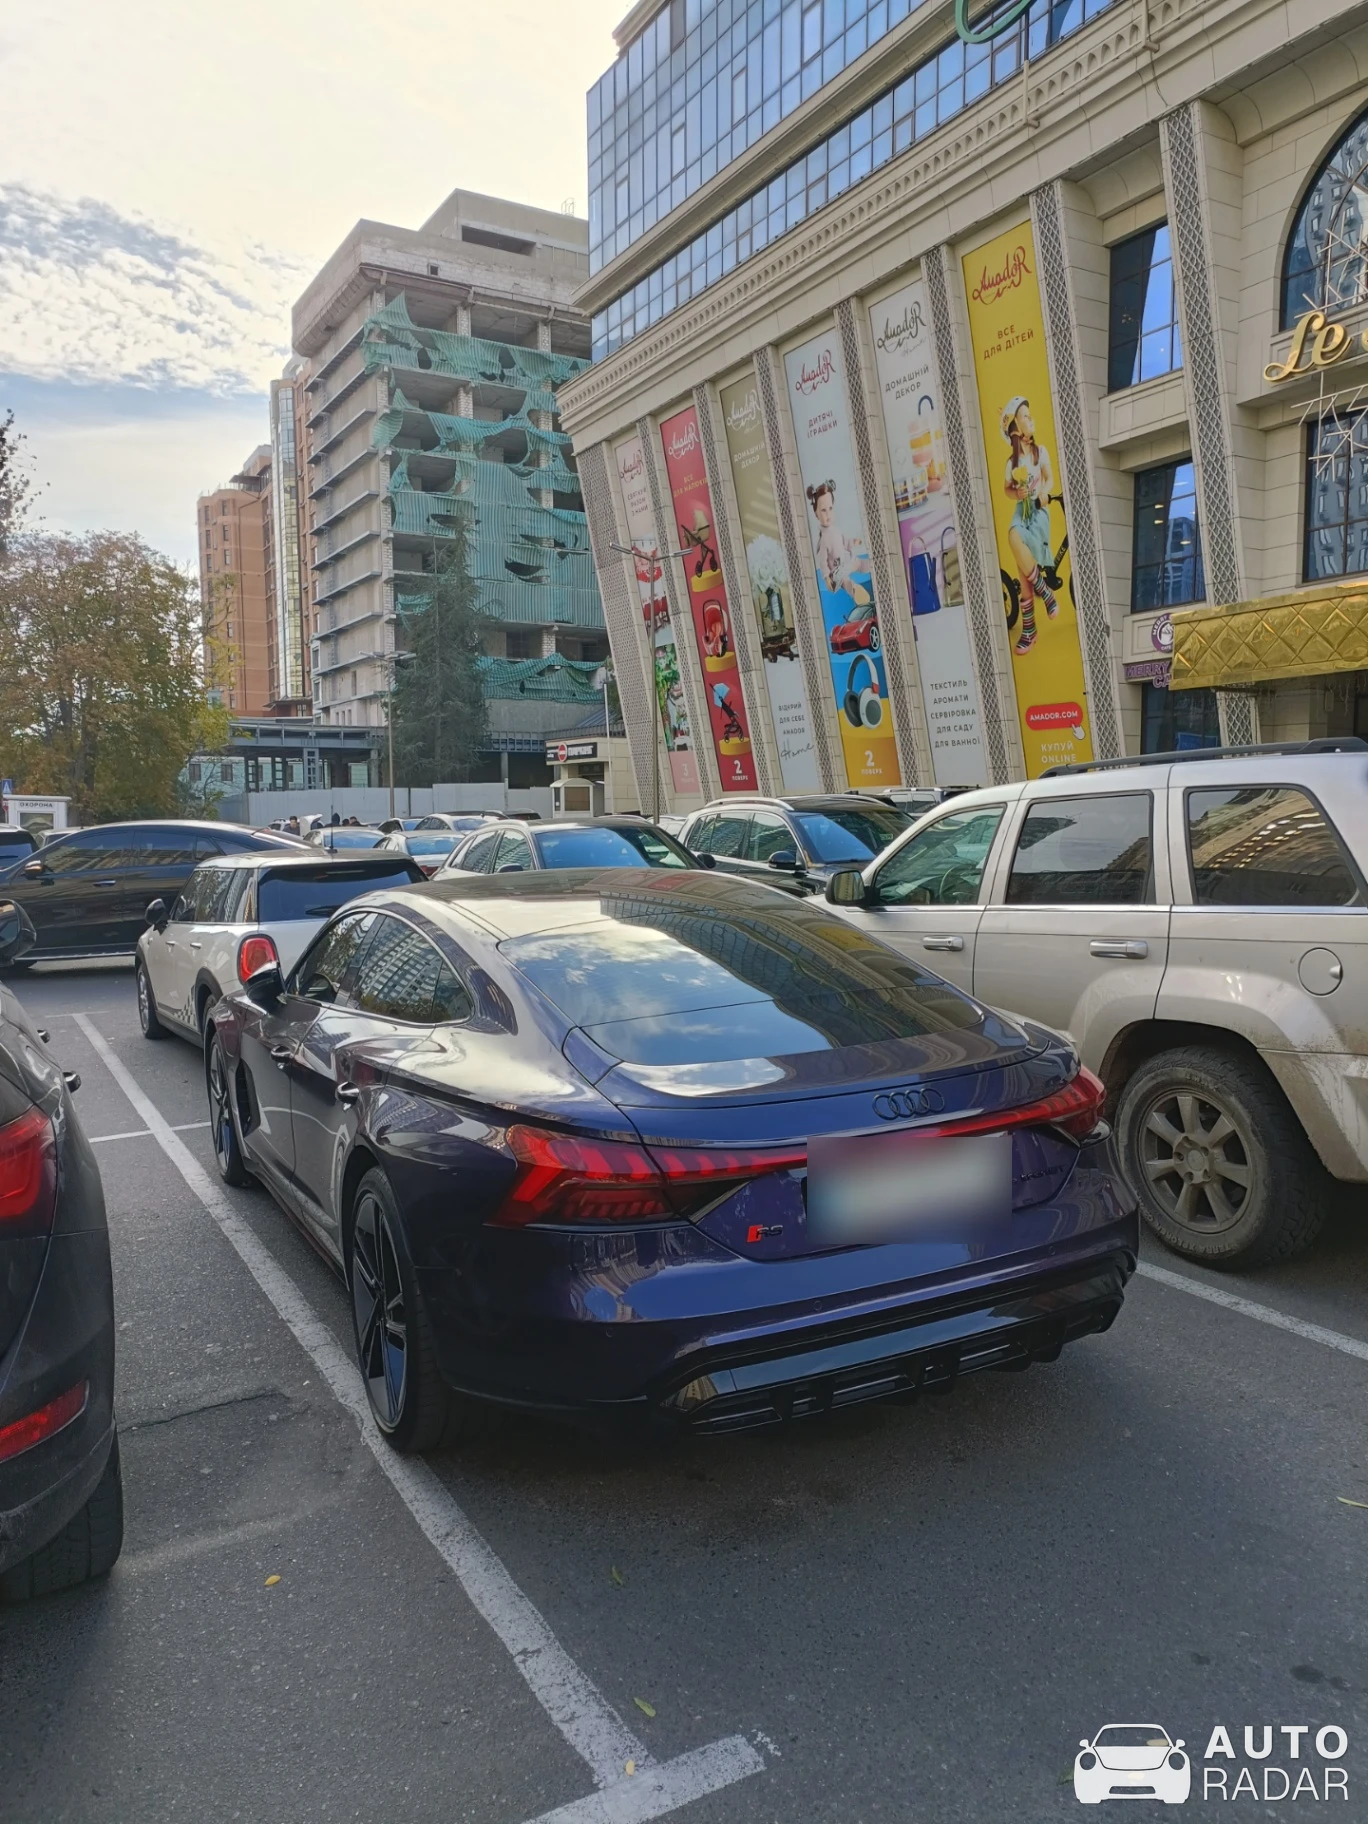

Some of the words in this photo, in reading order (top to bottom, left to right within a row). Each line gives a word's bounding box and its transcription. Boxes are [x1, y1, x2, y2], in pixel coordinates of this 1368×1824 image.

[997, 324, 1015, 339] ВСЕ
[983, 344, 1002, 360] ДЛЯ
[1005, 329, 1034, 351] ДІТЕЙ
[1264, 311, 1353, 382] Le
[885, 363, 929, 392] ДОМАШНІЙ
[895, 381, 921, 400] ДЕКОР
[808, 410, 833, 428] ДИТЯЧІ
[807, 419, 838, 438] ІГРАШКИ
[741, 455, 760, 469] ДЕКОР
[1126, 661, 1171, 678] MERRY
[930, 680, 968, 690] ТЕКСТИЛЬ
[778, 701, 802, 711] ВІДКРИЙ
[933, 694, 969, 705] АРОМАТИ
[930, 708, 976, 719] СЕРВІРОВКА
[1030, 711, 1078, 721] AMADOR.COM
[936, 726, 951, 734] ДЛЯ
[953, 724, 973, 732] САДУ
[935, 740, 949, 748] ДЛЯ
[951, 736, 980, 747] ВАННОЇ
[1041, 741, 1074, 752] КУПУЙ
[864, 750, 875, 767] 2
[1041, 753, 1077, 764] ONLINE
[682, 763, 689, 777] 3
[733, 759, 742, 774] 2
[755, 1225, 784, 1238] RS
